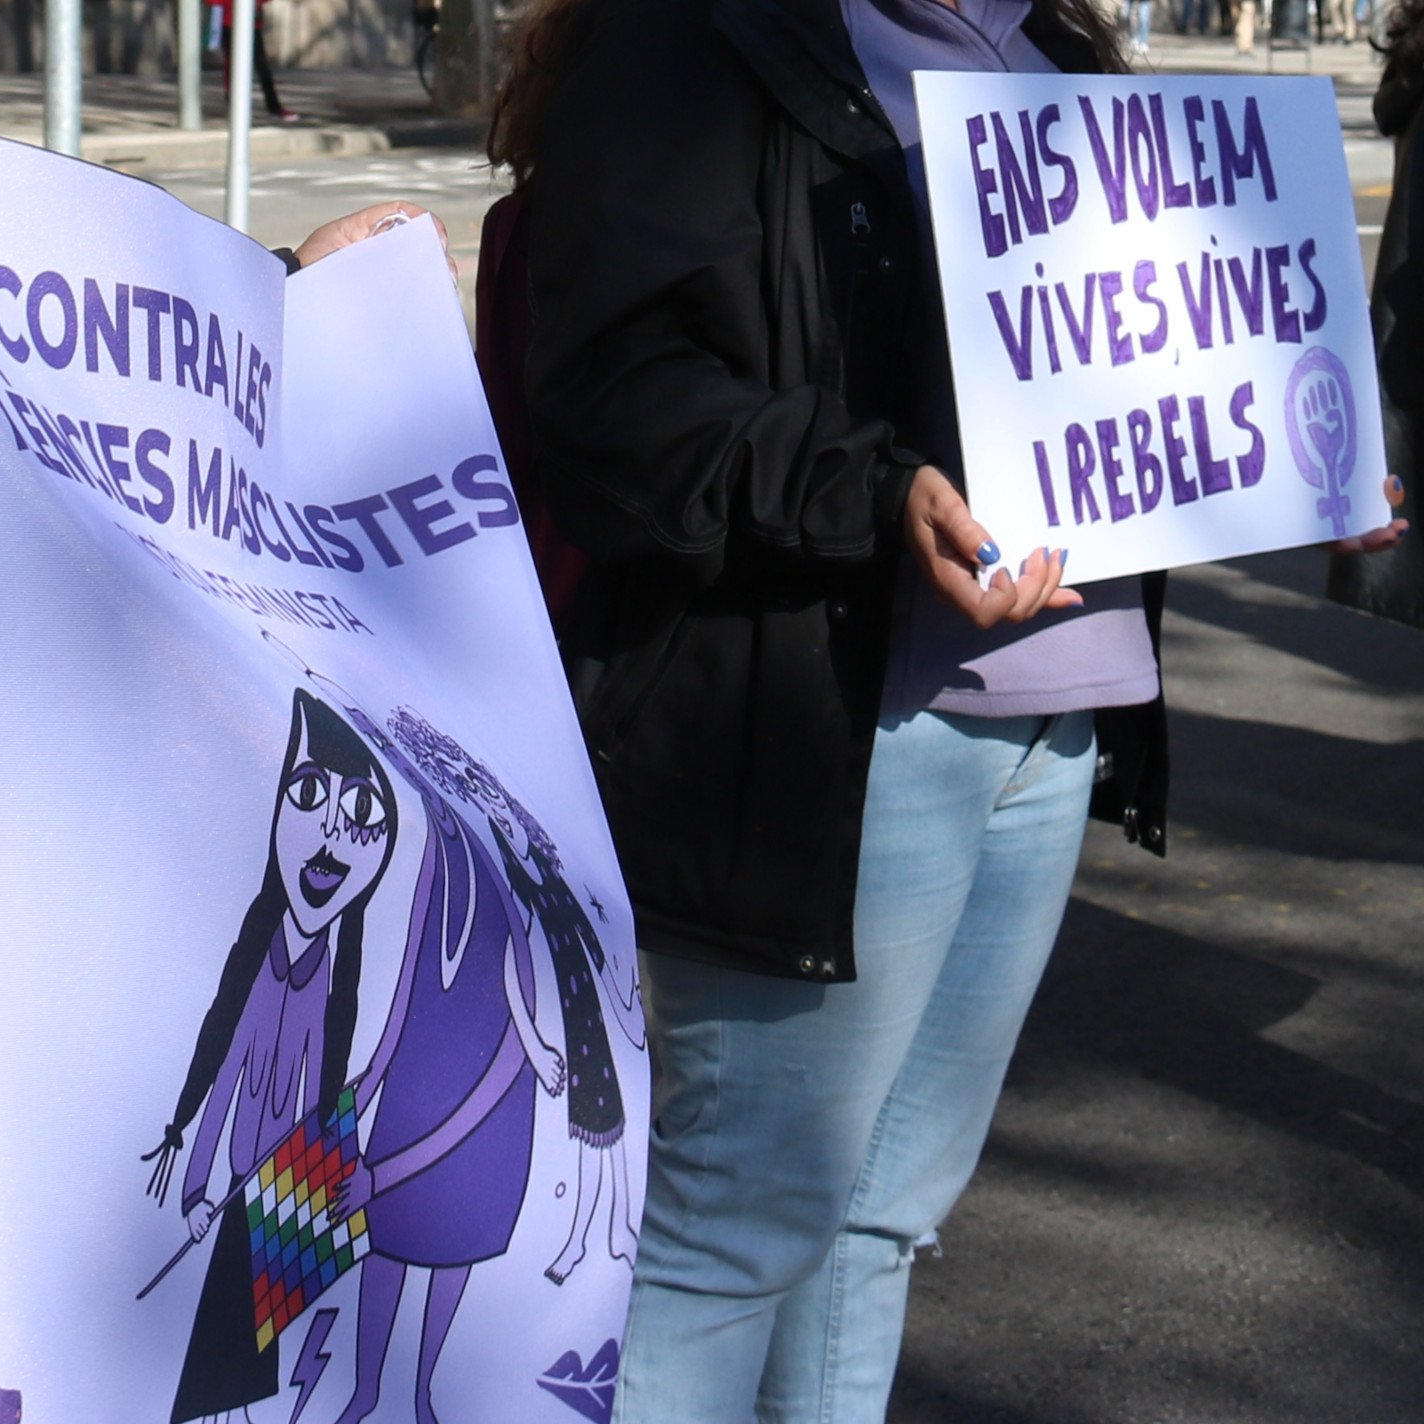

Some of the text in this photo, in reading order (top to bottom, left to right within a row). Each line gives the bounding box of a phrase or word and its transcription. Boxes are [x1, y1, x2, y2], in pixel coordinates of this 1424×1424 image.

[966, 92, 1277, 257] ENS VOLEM
[233, 329, 272, 450] LES
[1032, 380, 1266, 528] I REBELS
[187, 437, 520, 574] MASCLISTES
